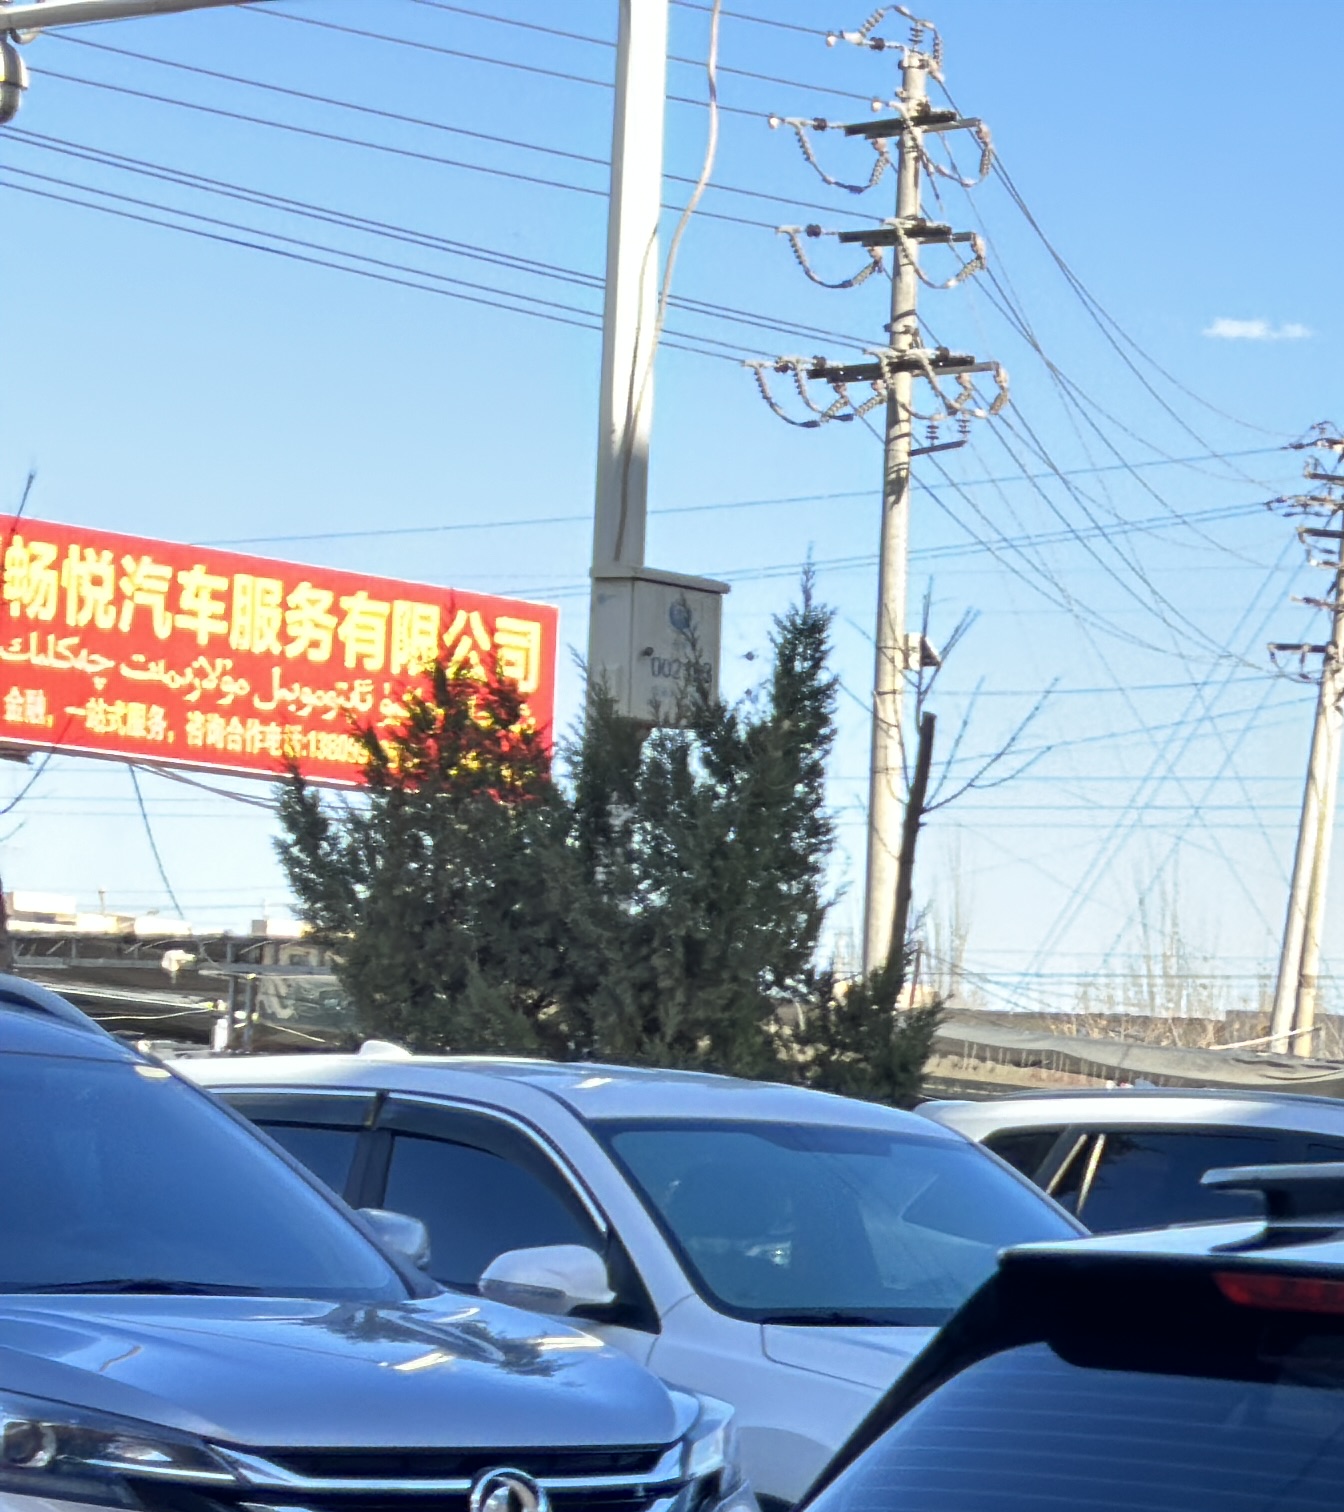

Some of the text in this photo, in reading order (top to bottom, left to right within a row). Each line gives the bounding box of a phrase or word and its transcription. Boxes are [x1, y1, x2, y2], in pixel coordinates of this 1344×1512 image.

[3, 535, 541, 693] 畅悦汽车服务有限公司
